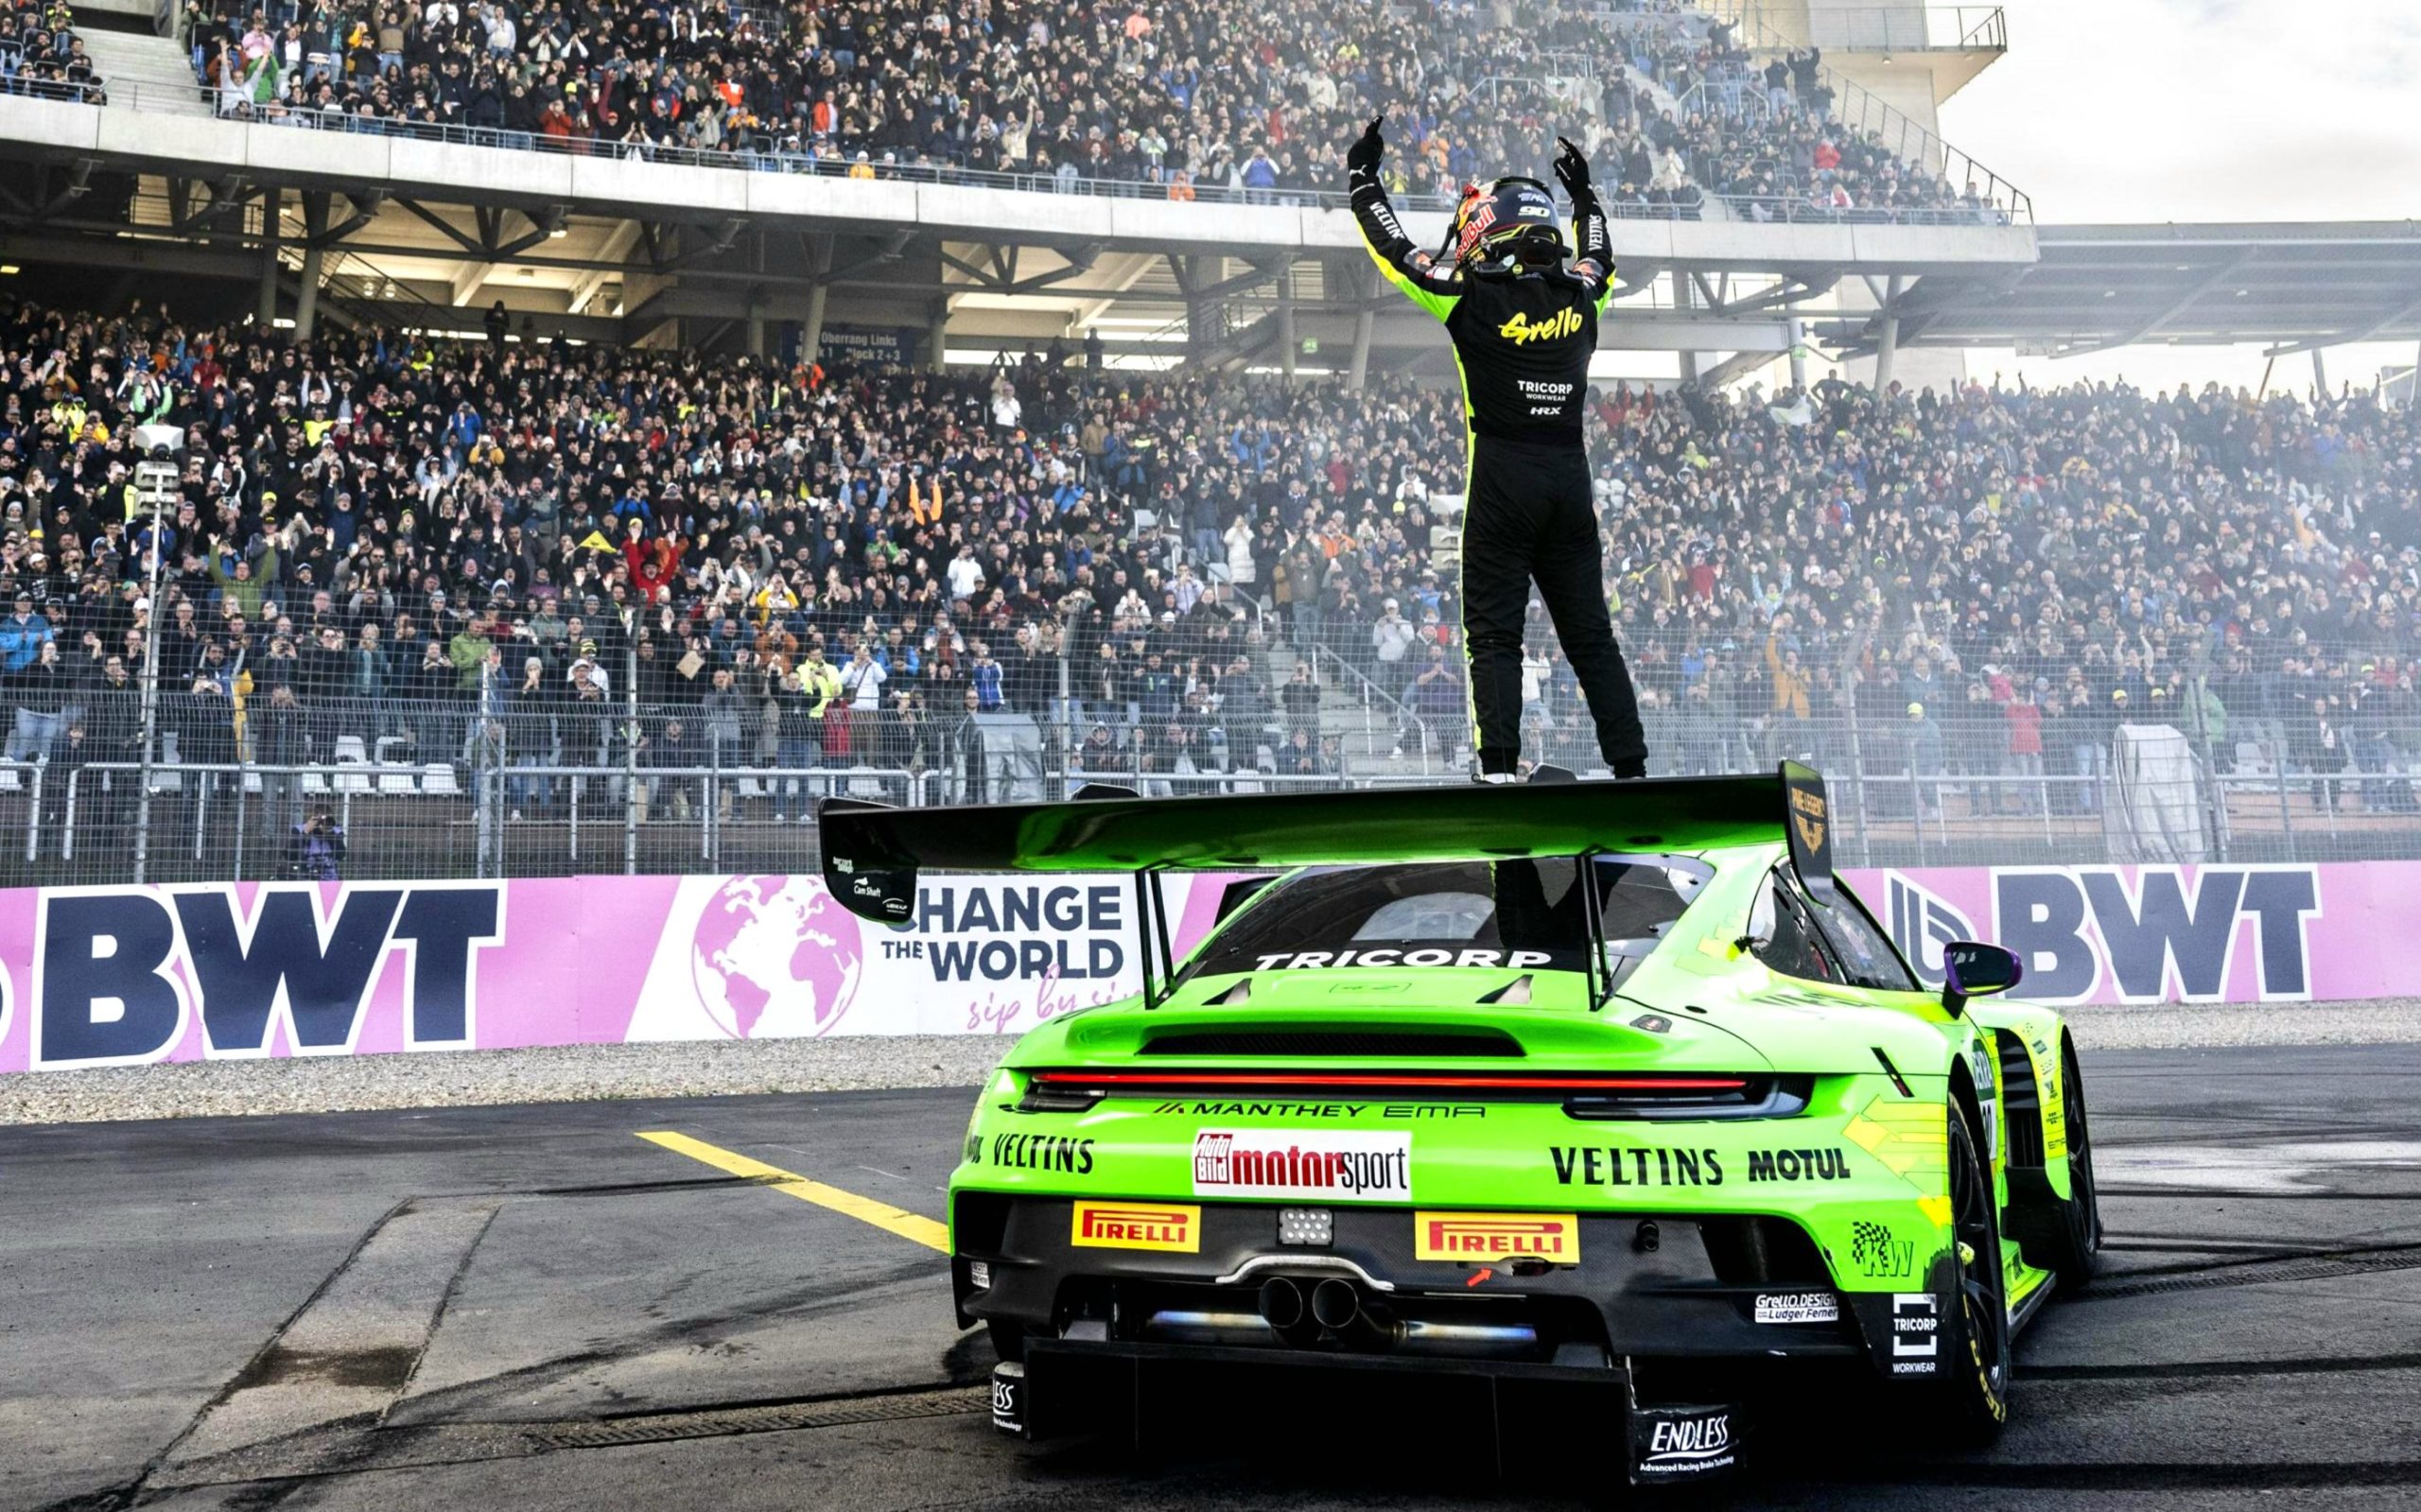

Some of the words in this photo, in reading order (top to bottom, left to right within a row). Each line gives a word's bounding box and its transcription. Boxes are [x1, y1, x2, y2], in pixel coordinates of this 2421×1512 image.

[1369, 201, 1405, 239] VELTIN
[1465, 204, 1496, 243] Bull
[1518, 205, 1550, 217] 90
[1498, 305, 1583, 346] Grello
[821, 332, 867, 346] Oberrang
[871, 335, 897, 346] Links
[827, 347, 832, 357] 1
[877, 350, 883, 359] 2
[894, 351, 900, 361] 3
[1517, 380, 1574, 394] TRICORP
[1525, 393, 1566, 402] WORKWEAR
[854, 885, 866, 895] Cam
[885, 886, 1123, 932] HANGE
[1997, 871, 2316, 999] BWT
[881, 941, 923, 960] THE
[929, 939, 1123, 982] WORLD
[1255, 949, 1552, 970] TRICORP
[41, 889, 499, 1062] BWT
[967, 992, 1020, 1034] sip
[1192, 1103, 1367, 1118] MANTHEY
[1383, 1105, 1486, 1119] EMA
[994, 1133, 1094, 1174] VELTINS
[1196, 1135, 1230, 1157] Auto
[1196, 1156, 1228, 1182] Bild
[1232, 1146, 1407, 1194] motorsport
[1550, 1146, 1723, 1186] VELTINS
[1749, 1147, 1851, 1182] MOTUL
[1082, 1208, 1189, 1243] PIRELLI
[1429, 1221, 1564, 1254] PIRELLI
[1863, 1240, 1914, 1277] KW
[1768, 1309, 1804, 1322] Ludger
[1894, 1318, 1937, 1331] TRICORP
[1893, 1362, 1935, 1374] WORKWEAR
[1650, 1415, 1729, 1451] ENDLESS
[1640, 1462, 1678, 1472] Advanced
[1678, 1462, 1699, 1472] Racing
